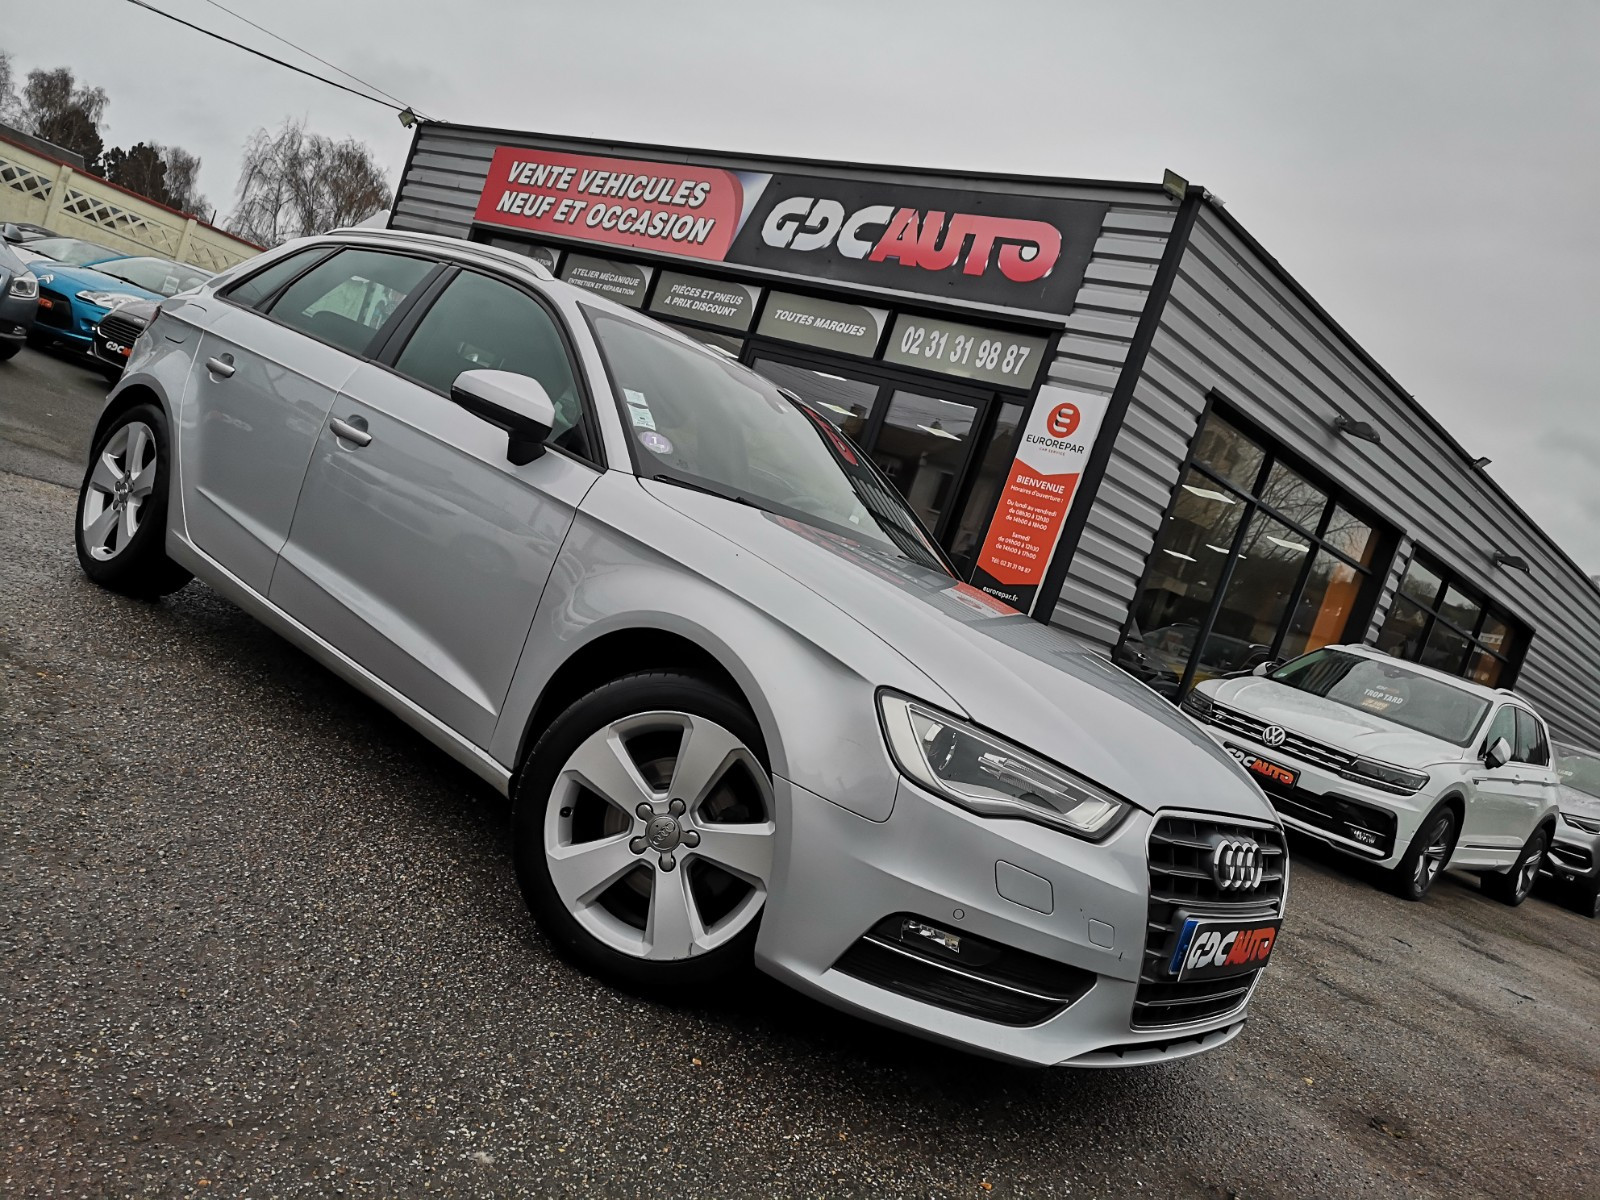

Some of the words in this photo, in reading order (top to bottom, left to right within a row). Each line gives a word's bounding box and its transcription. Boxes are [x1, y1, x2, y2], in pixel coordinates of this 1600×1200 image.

[508, 161, 577, 190] VENTE
[578, 169, 711, 208] VEHICULES
[496, 190, 556, 218] NEUF
[553, 198, 587, 224] ET
[586, 203, 715, 244] OCCASION
[567, 278, 595, 289] ENTRETIEN
[594, 282, 602, 290] ET
[601, 283, 635, 296] RÉPARATION
[572, 267, 600, 279] ATELIER
[600, 271, 640, 287] MÉCANIQUE
[664, 296, 671, 304] A
[671, 297, 692, 308] PRIX
[692, 301, 737, 316] DISCOUNT
[701, 289, 713, 299] ET
[713, 292, 744, 305] PNEUS
[774, 309, 814, 326] TOUTES
[813, 317, 866, 336] MARQUES
[901, 326, 925, 355] 02
[924, 331, 949, 360] 31
[950, 335, 975, 364] 31
[975, 340, 1002, 370] 98
[1002, 345, 1031, 375] 87
[1026, 434, 1085, 454] EUROREPAR
[1010, 485, 1031, 495] Horaires
[1016, 474, 1065, 494] BIENVENUE
[1015, 500, 1027, 509] lundi
[1035, 507, 1057, 517] vendredi
[1012, 531, 1030, 541] Samedi
[982, 586, 1018, 602] eurorepar.fr
[1363, 688, 1384, 699] TROP
[1383, 693, 1404, 705] TARD
